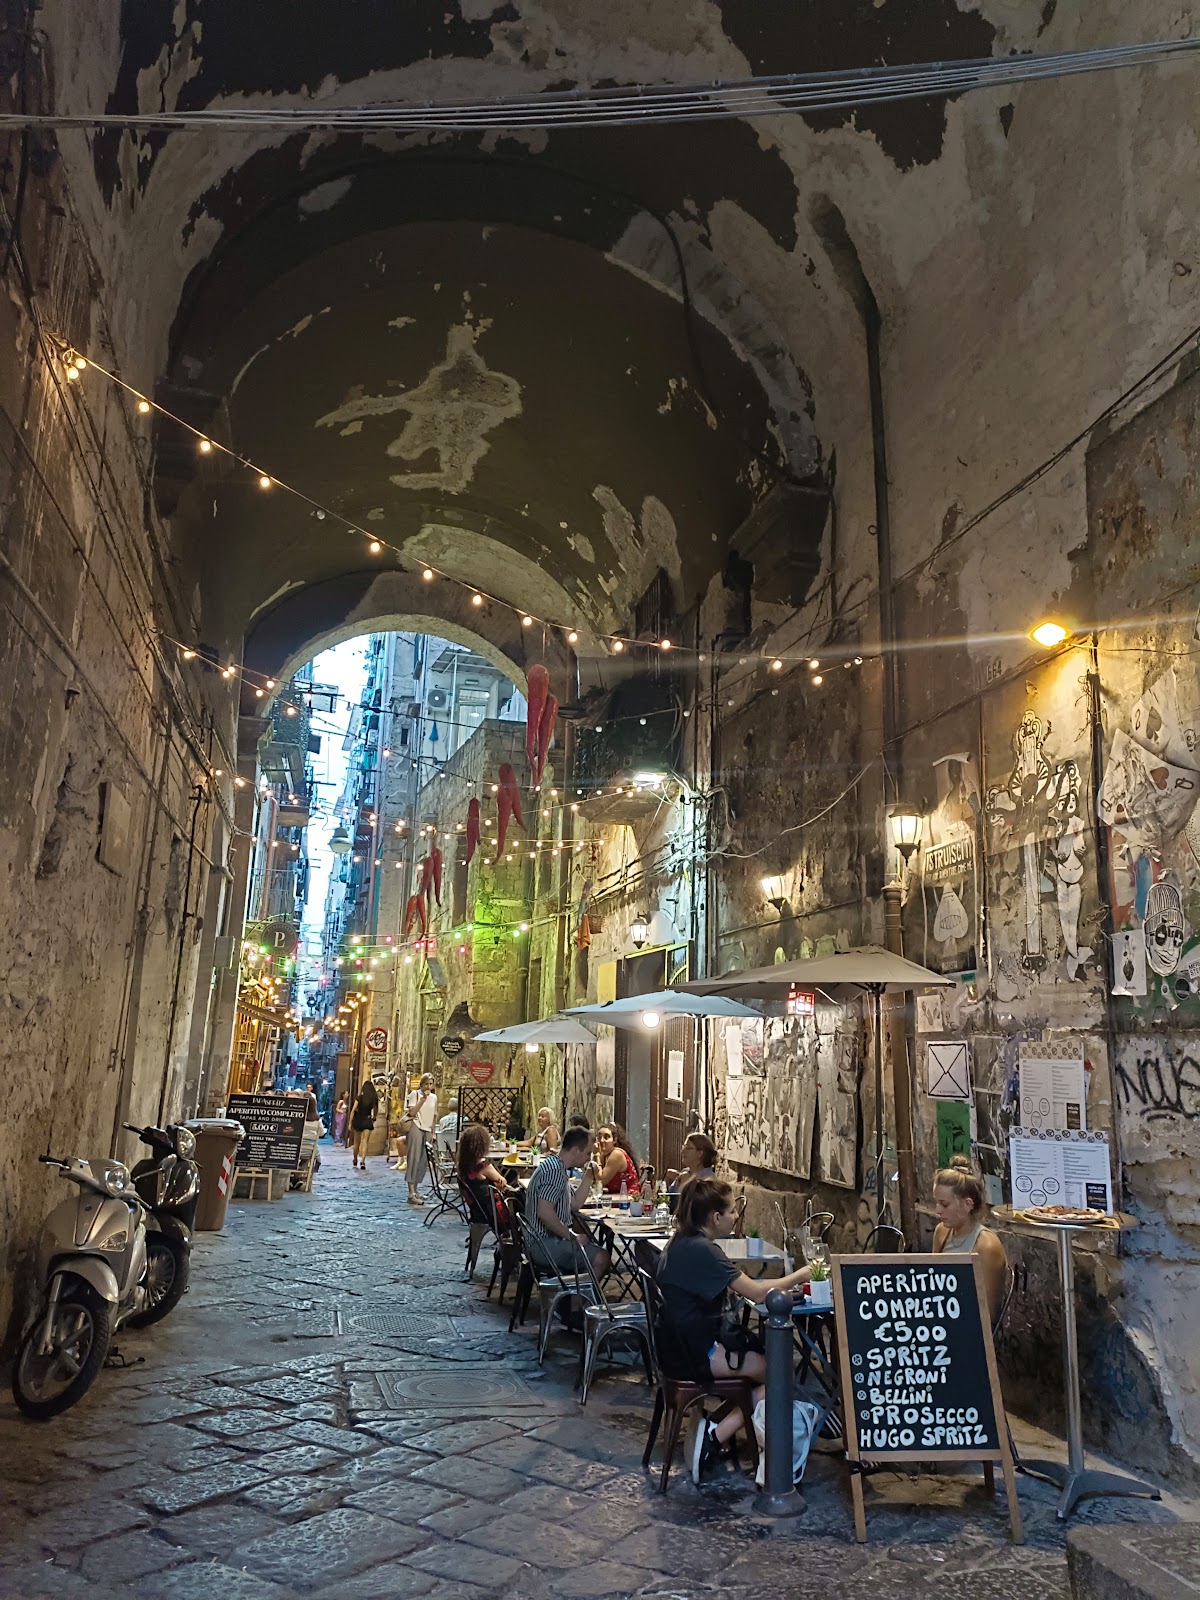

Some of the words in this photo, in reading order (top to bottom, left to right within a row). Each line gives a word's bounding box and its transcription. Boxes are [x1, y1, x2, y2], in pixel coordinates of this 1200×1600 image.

[859, 1295, 961, 1320] COMPLETO
[870, 1405, 979, 1425] PROSECCO
[860, 1428, 915, 1448] HUGO
